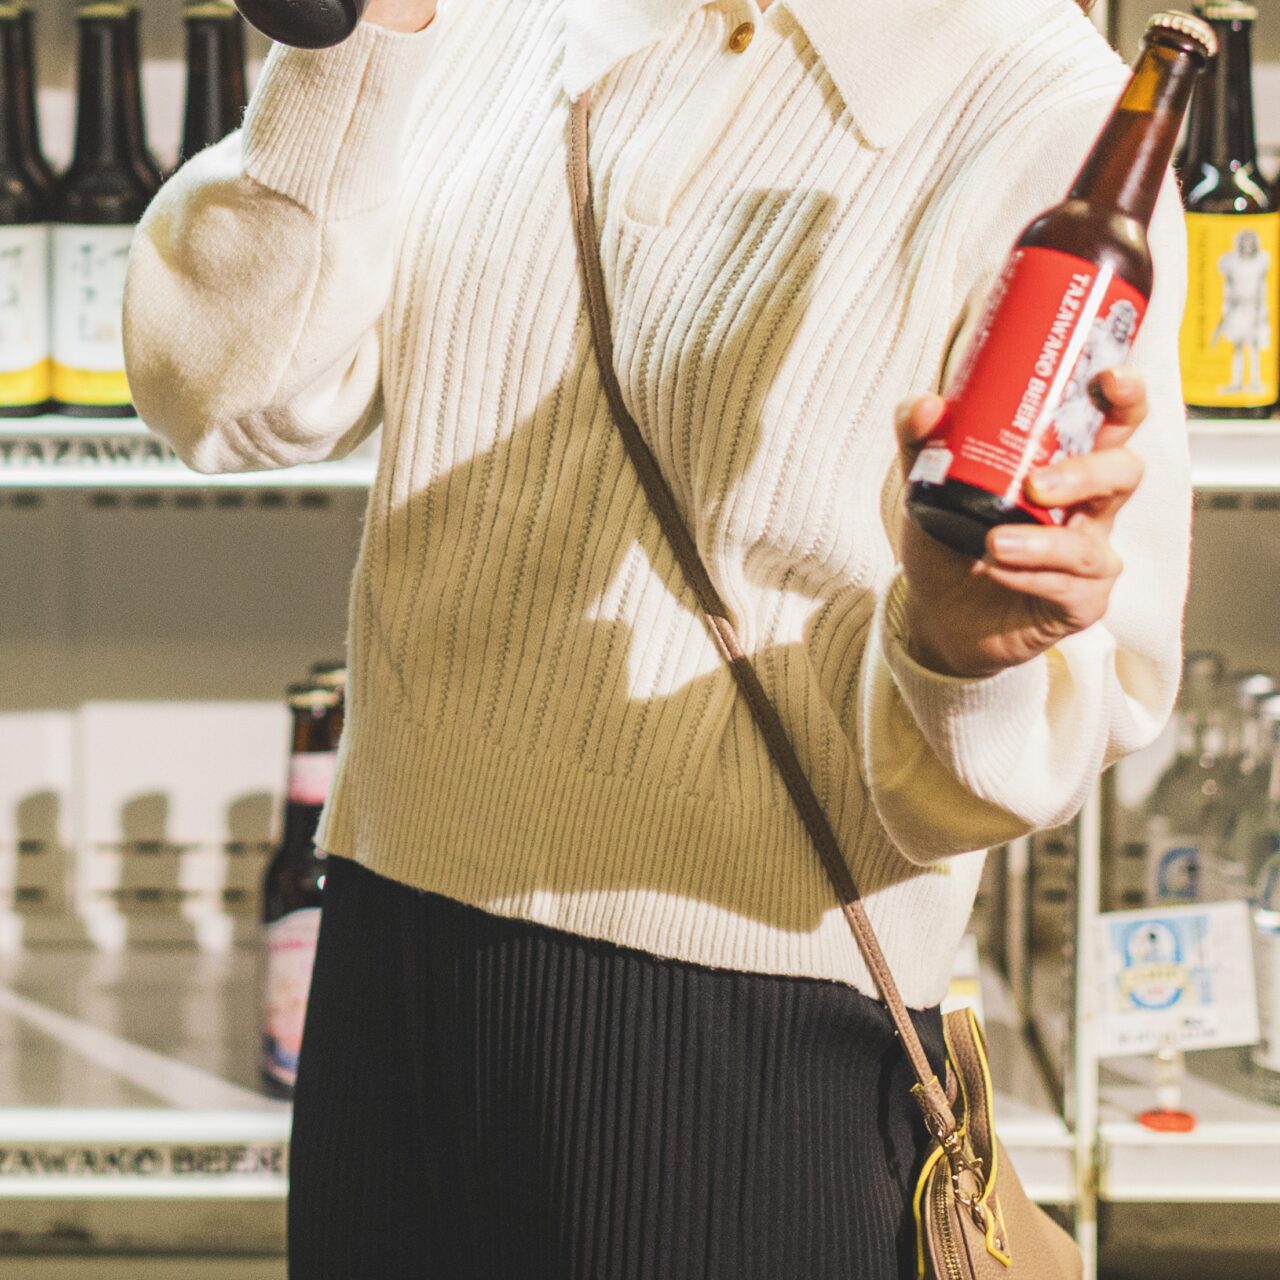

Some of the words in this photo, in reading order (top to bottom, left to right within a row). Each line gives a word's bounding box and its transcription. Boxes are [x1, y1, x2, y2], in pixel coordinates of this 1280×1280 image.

[1034, 273, 1091, 378] TAZAWAKO
[1011, 377, 1047, 432] BEER
[171, 1145, 283, 1175] BEER
